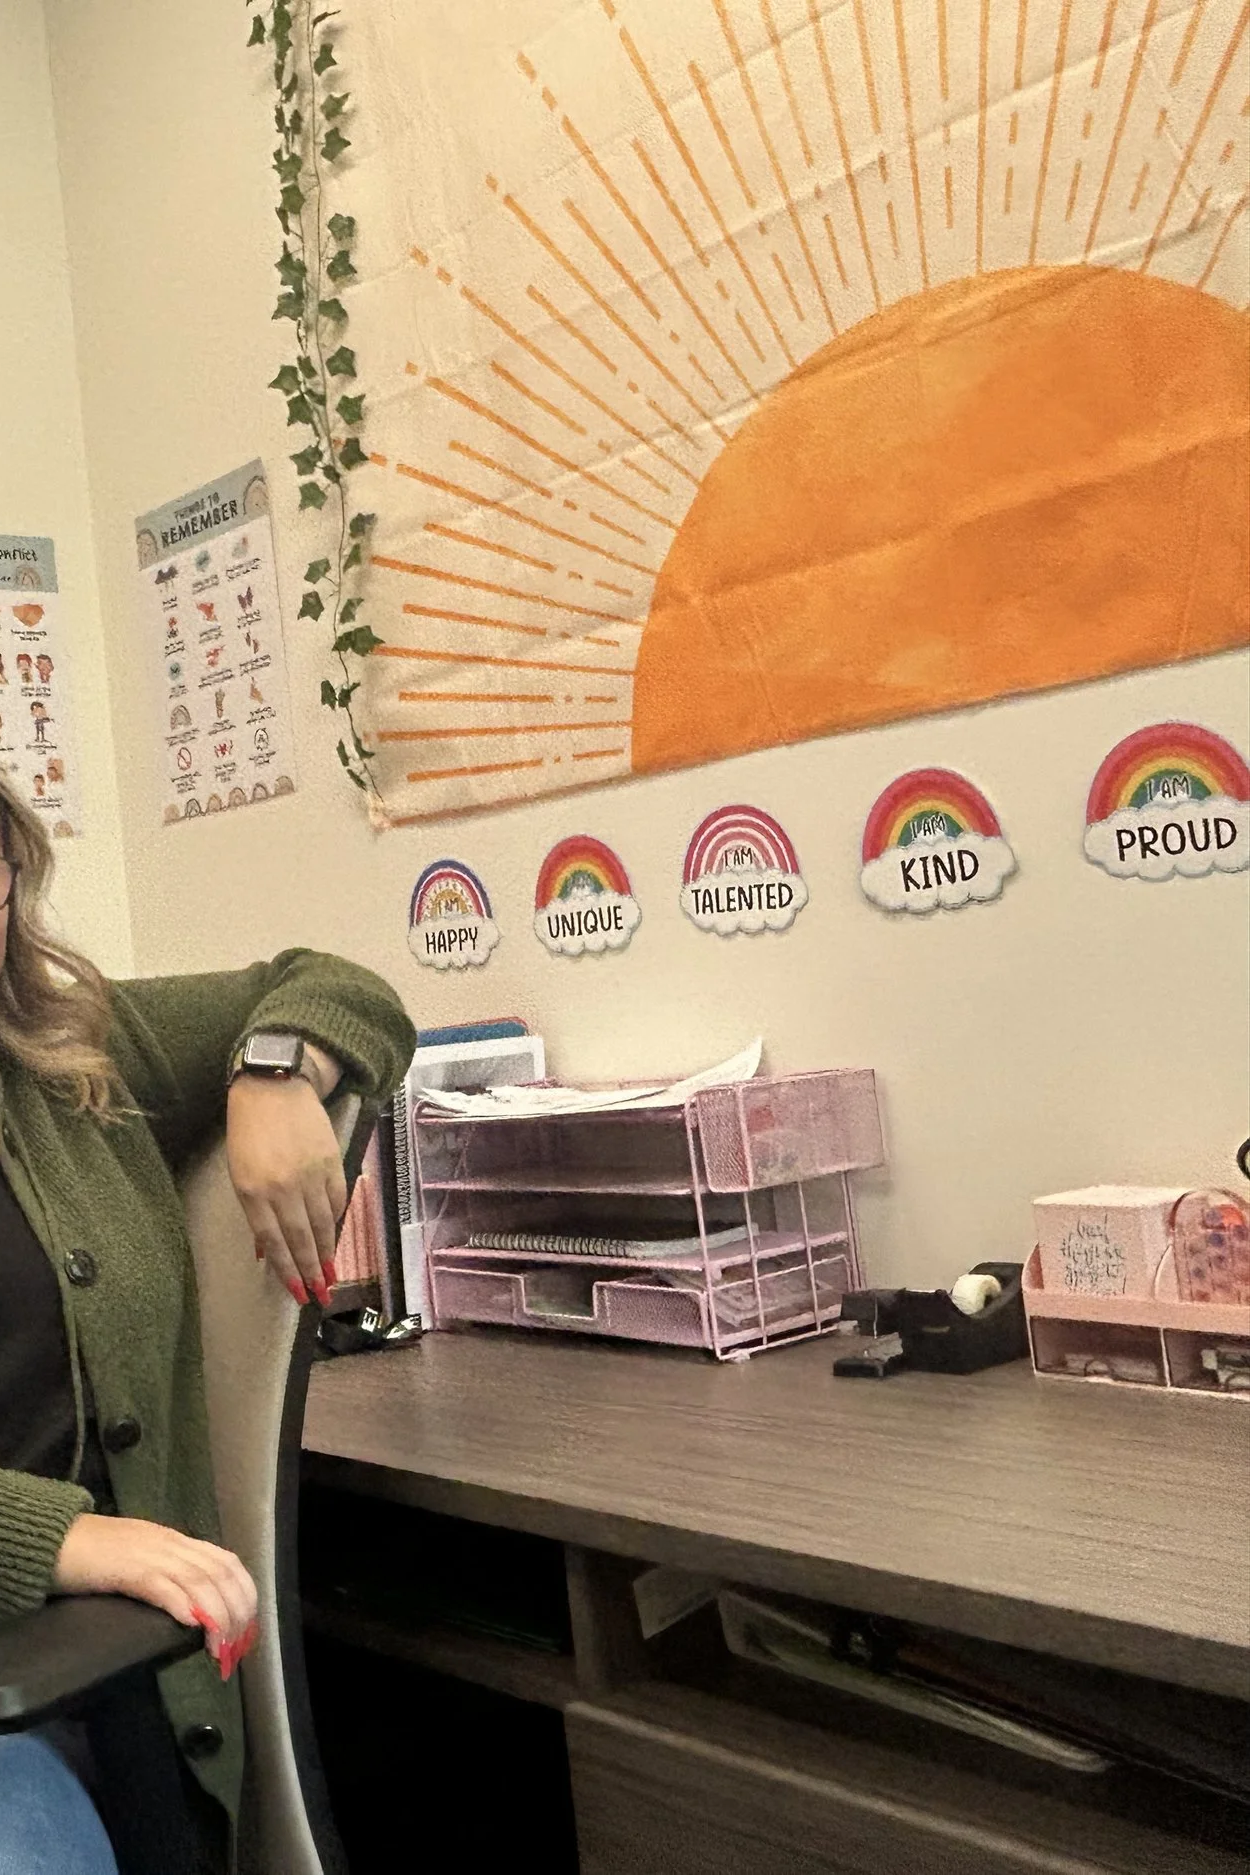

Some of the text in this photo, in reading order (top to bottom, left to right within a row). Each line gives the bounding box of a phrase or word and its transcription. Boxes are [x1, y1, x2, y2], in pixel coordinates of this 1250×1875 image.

[160, 500, 238, 549] REMEMBER
[1161, 775, 1190, 799] AM
[922, 813, 946, 836] AM
[1116, 817, 1238, 862] PROUD
[733, 846, 753, 865] AM
[900, 849, 979, 892] KIND
[691, 882, 794, 915] TALENTED
[547, 905, 624, 939] UNIQUE
[425, 926, 478, 955] HAPPY
